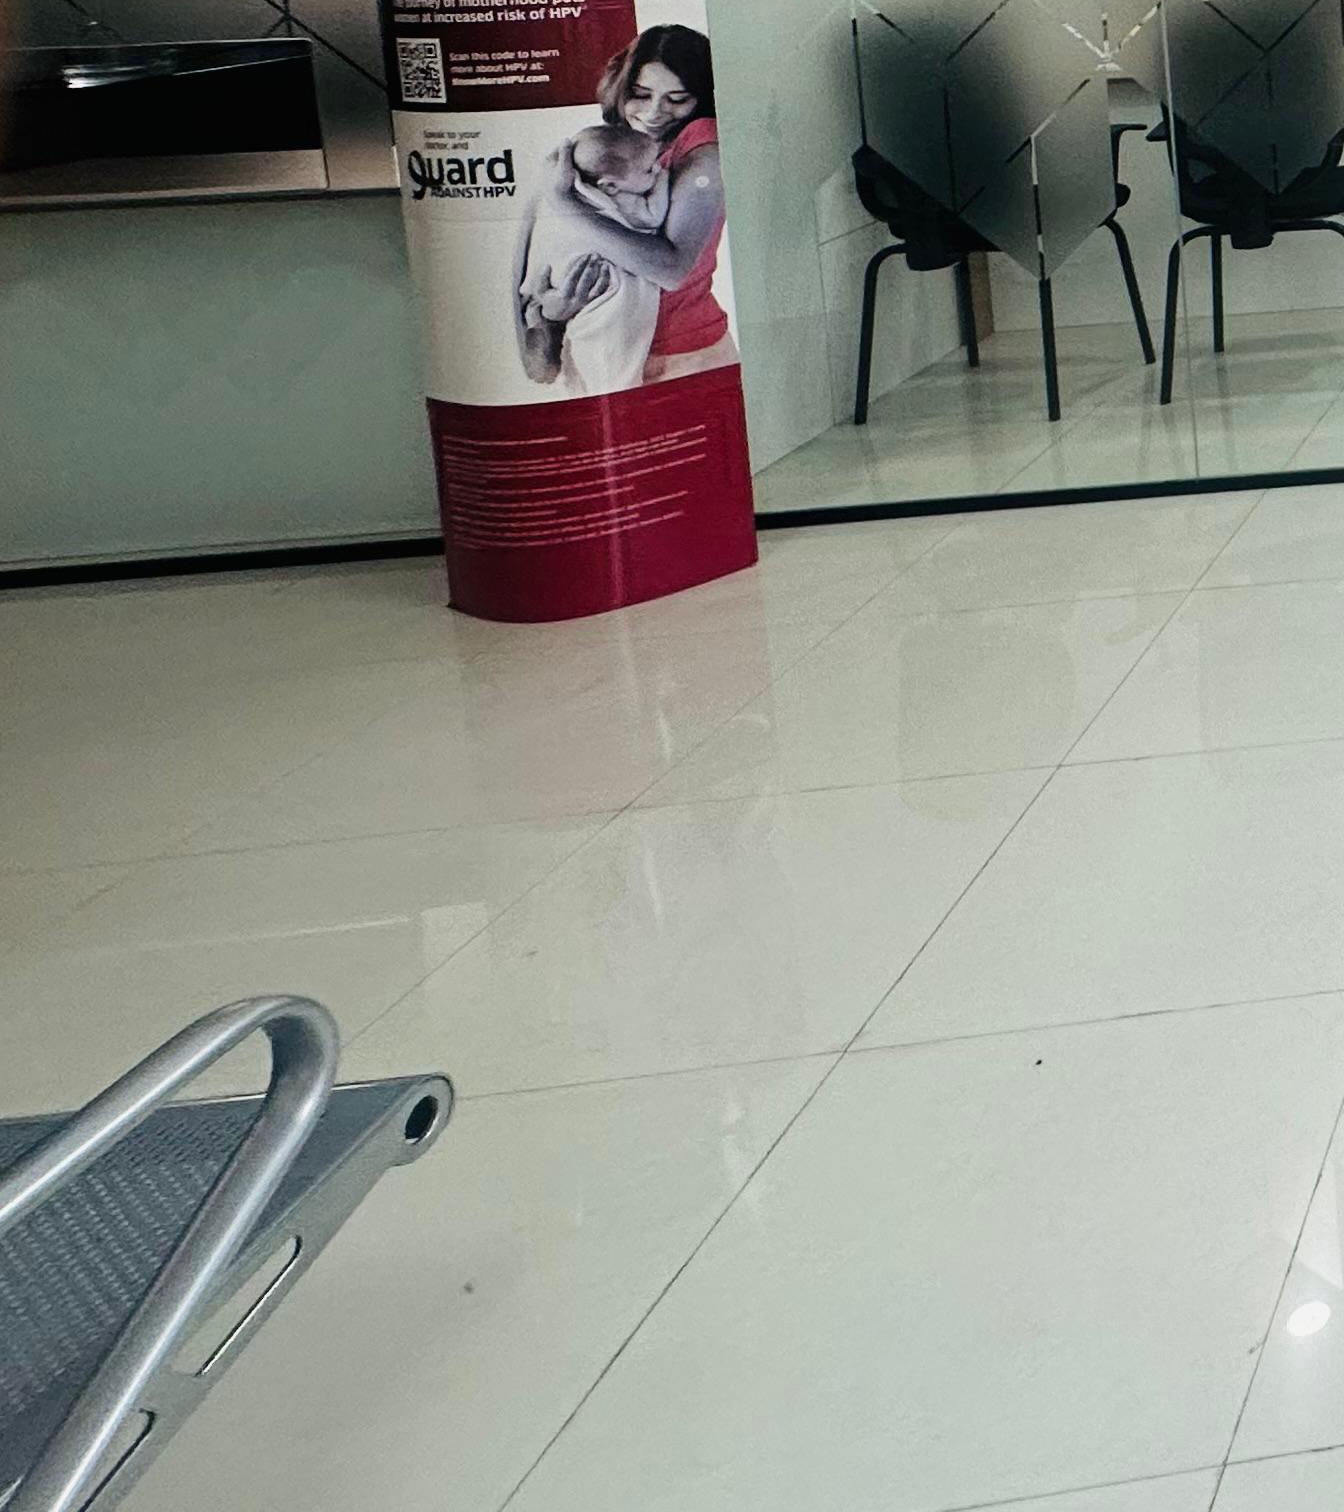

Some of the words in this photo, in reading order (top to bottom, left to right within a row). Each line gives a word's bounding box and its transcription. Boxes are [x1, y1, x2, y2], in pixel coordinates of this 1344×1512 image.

[433, 10, 494, 23] increased
[497, 9, 526, 21] risk
[529, 7, 546, 20] of
[549, 6, 581, 19] HPV
[517, 50, 530, 59] to
[530, 49, 560, 58] learn
[459, 131, 481, 140] your
[483, 185, 516, 198] HPV
